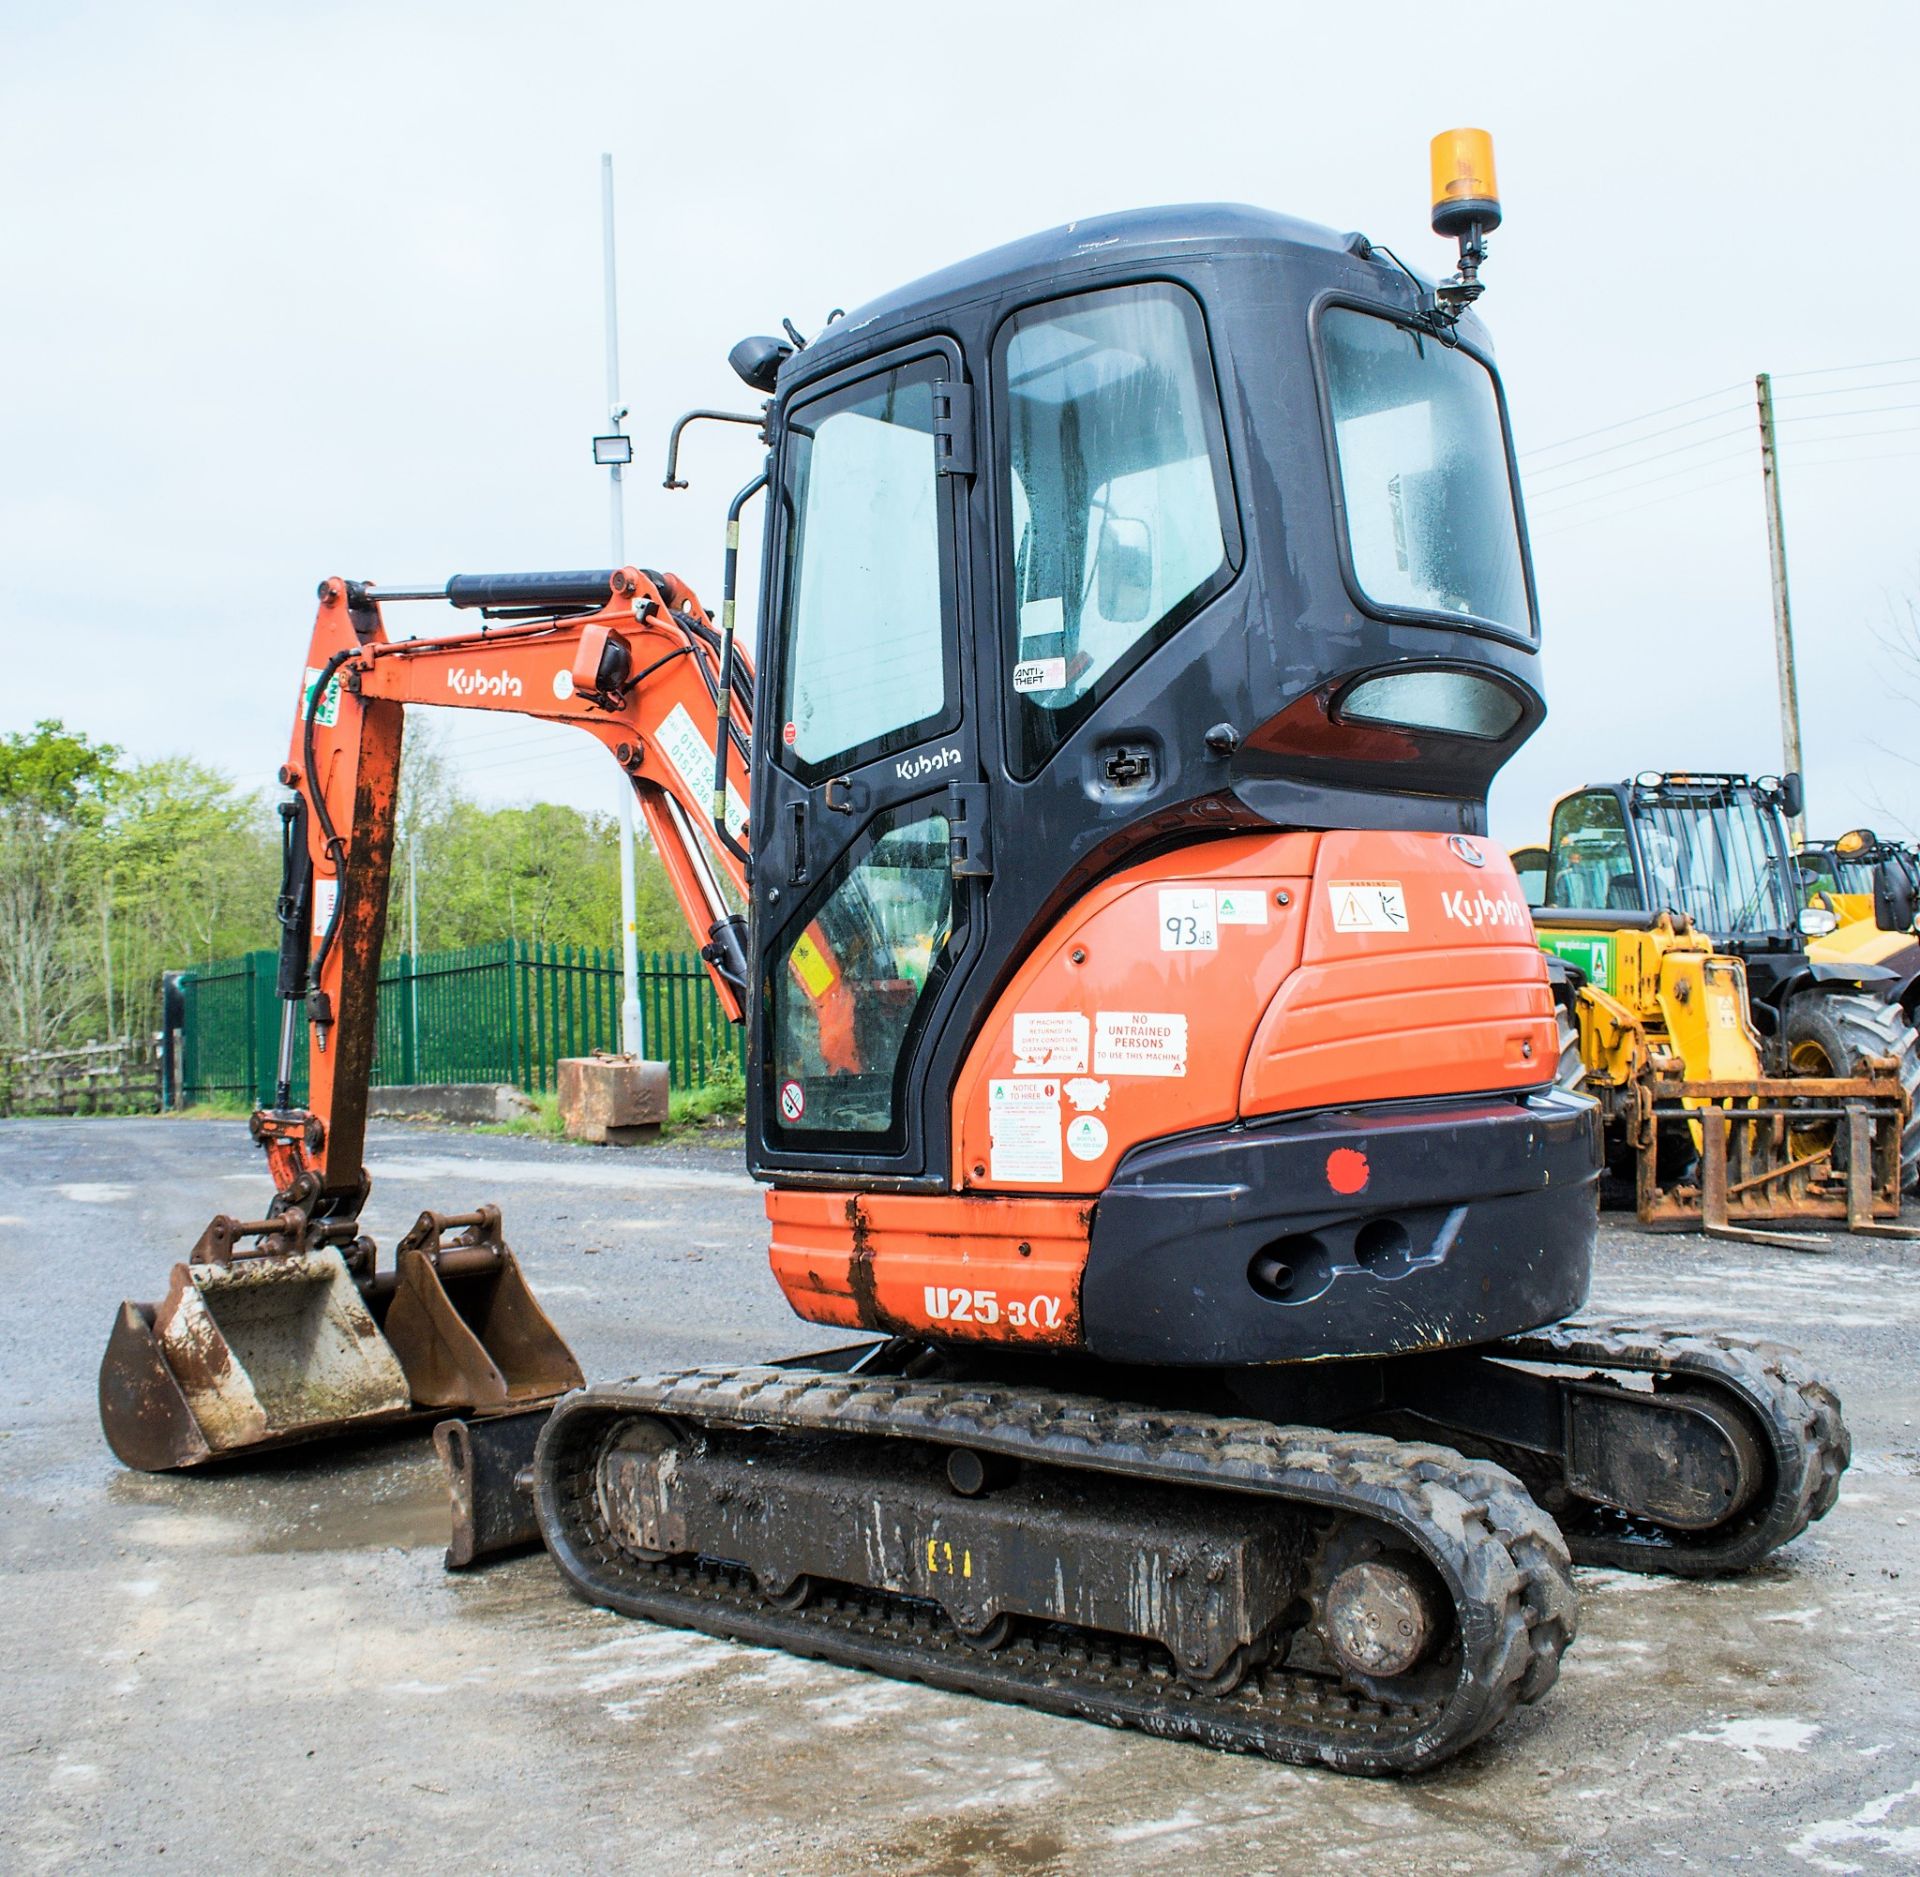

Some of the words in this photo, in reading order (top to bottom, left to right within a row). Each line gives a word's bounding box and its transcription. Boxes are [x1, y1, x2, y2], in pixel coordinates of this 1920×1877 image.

[447, 668, 522, 697] Kubota
[1015, 676, 1044, 686] THEFT
[680, 733, 703, 766] 0151
[672, 745, 693, 777] 0151
[895, 747, 962, 780] Kubota
[1440, 889, 1525, 928] Kubota
[1166, 917, 1197, 945] 93
[1132, 1015, 1148, 1024] NO
[1108, 1026, 1171, 1037] UNTRAINED
[1115, 1037, 1164, 1048] PERSONS
[1097, 1051, 1107, 1059] TO
[1146, 1053, 1181, 1061] MACHINE
[1013, 1084, 1038, 1092] NOTICE
[1010, 1092, 1020, 1100] TO
